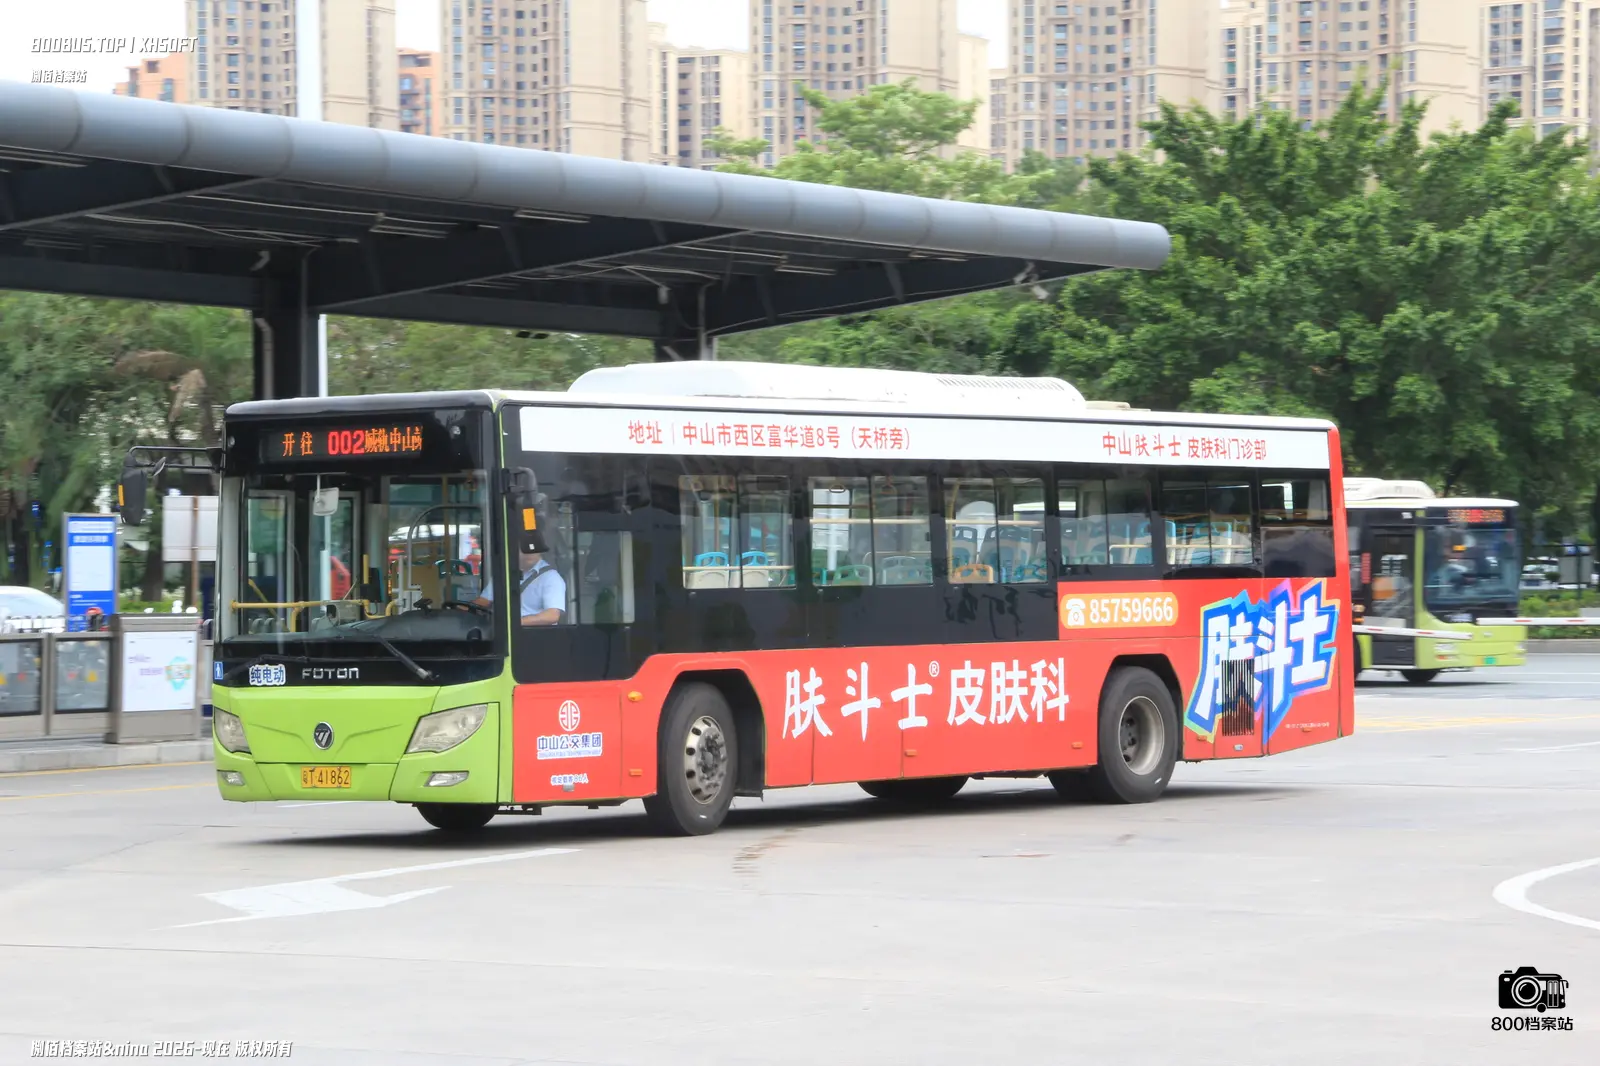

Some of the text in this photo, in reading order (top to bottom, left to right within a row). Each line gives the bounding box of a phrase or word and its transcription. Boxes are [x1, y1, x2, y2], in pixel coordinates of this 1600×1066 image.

[327, 430, 365, 455] 002
[628, 420, 662, 445] 地址
[1187, 437, 1267, 461] 皮肤科门诊部
[1089, 596, 1174, 624] 85759666
[250, 665, 286, 685] 纯电动
[302, 667, 359, 680] FOTON
[946, 657, 1070, 726] 皮肤科
[538, 733, 602, 750] 中山公交集团
